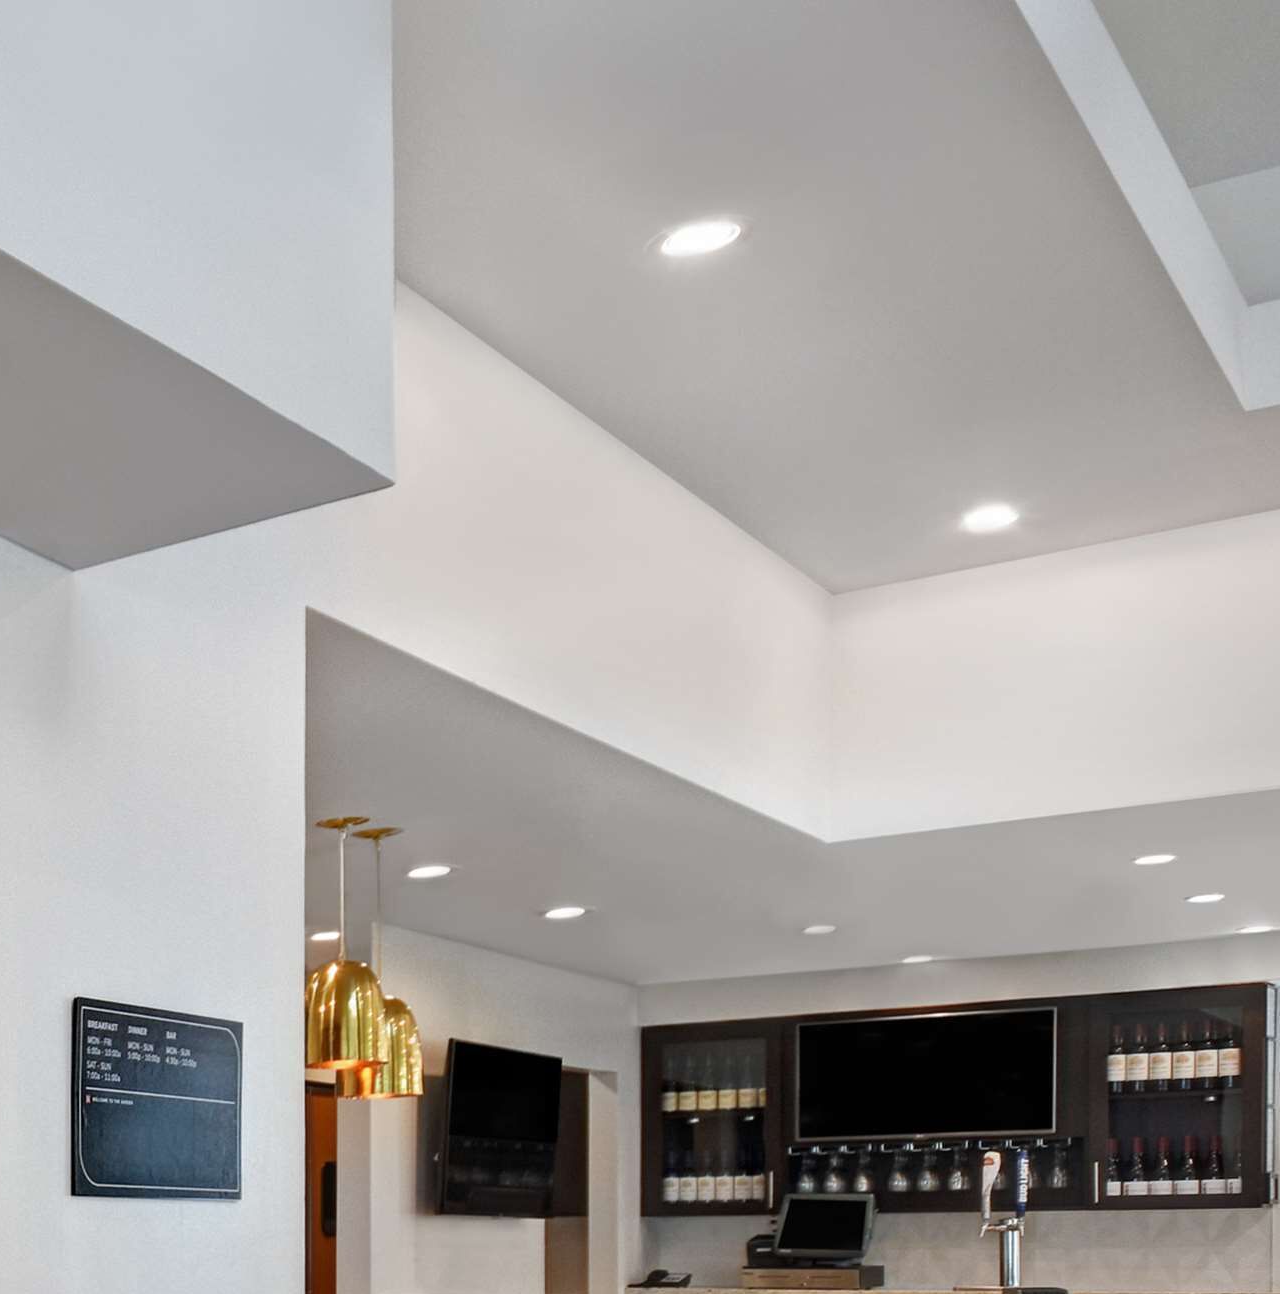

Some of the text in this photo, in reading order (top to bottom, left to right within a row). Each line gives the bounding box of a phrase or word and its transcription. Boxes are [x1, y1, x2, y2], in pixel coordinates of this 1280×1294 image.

[87, 1020, 119, 1031] BREAKFAST
[128, 1025, 148, 1036] DINNER
[87, 1036, 100, 1045] MON
[166, 1031, 177, 1040] BAR
[127, 1041, 154, 1052] MON SUN
[165, 1046, 191, 1057] MON SUN
[86, 1060, 112, 1071] SAT SUN
